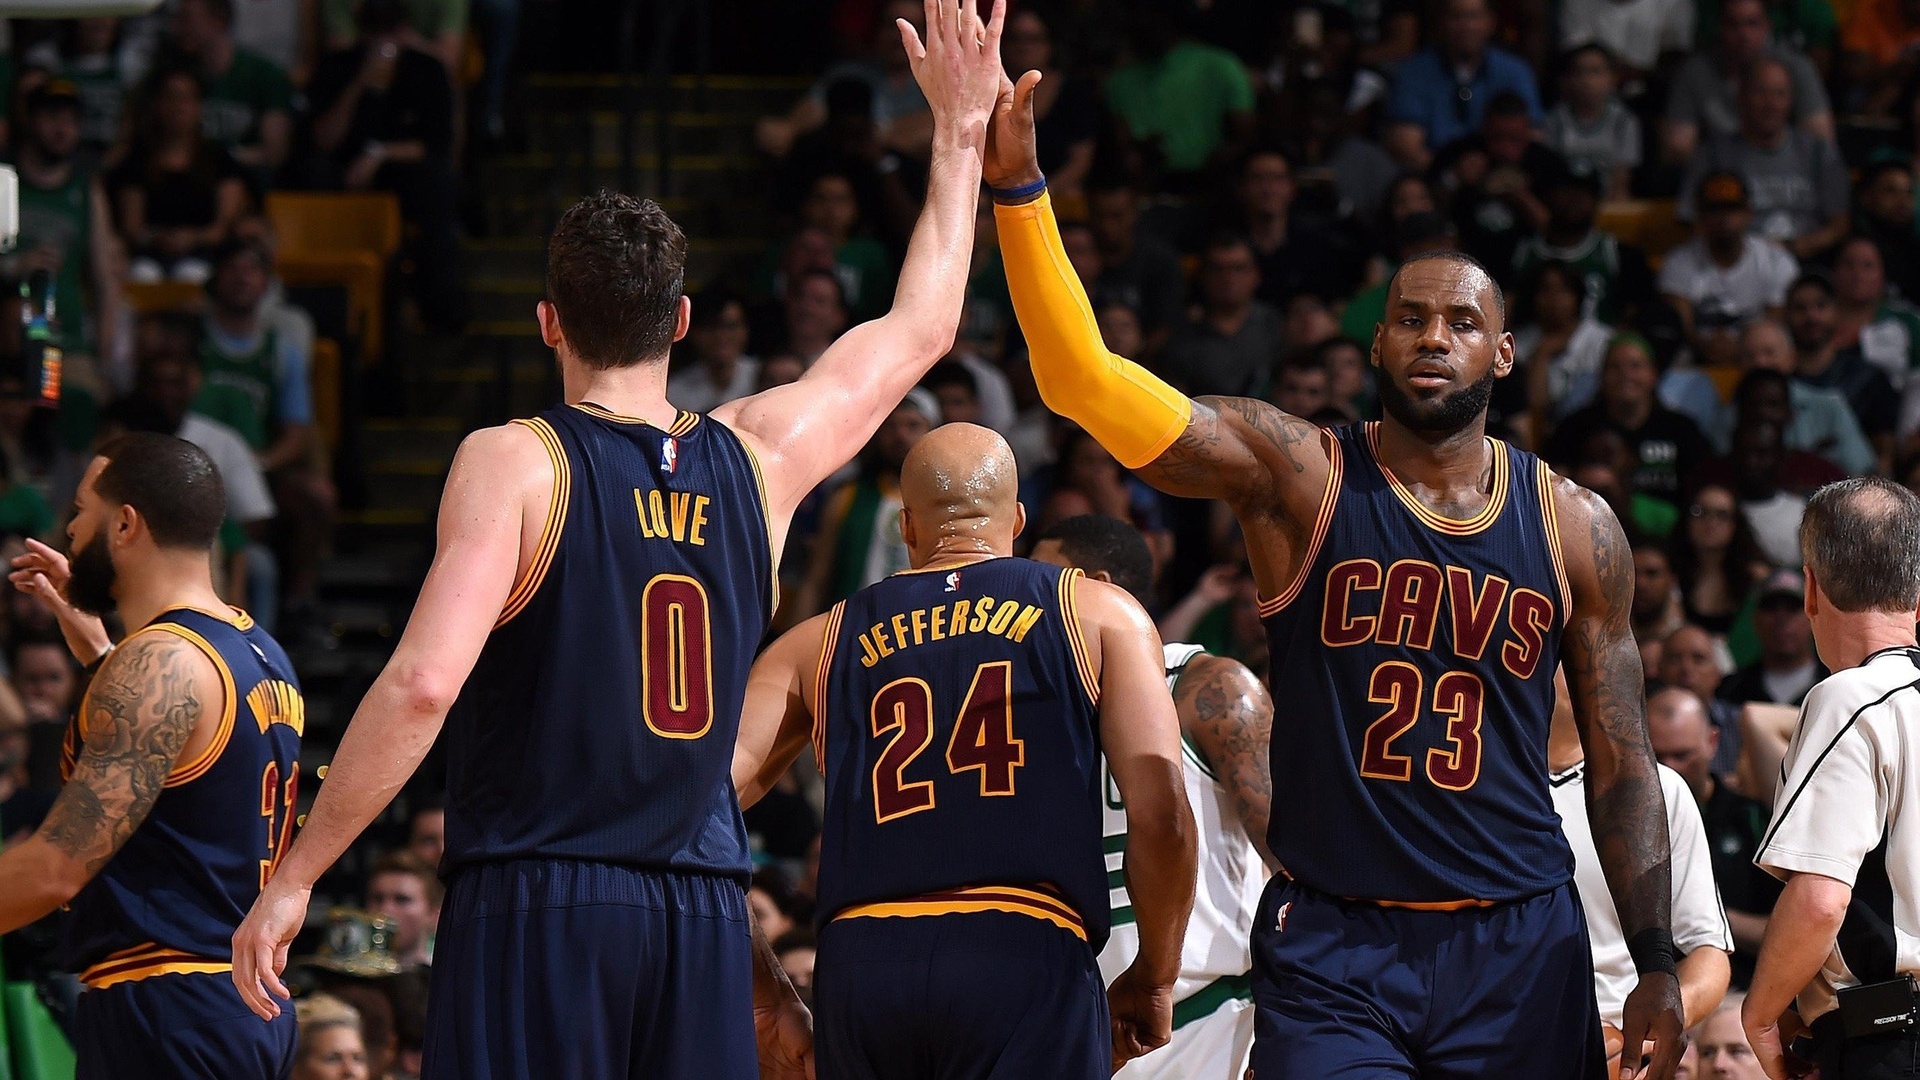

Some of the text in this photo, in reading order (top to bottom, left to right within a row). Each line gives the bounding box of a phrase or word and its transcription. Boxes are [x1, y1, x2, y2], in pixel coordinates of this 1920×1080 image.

[633, 488, 710, 546] LOVE
[641, 573, 714, 740] 0
[858, 596, 1044, 668] JEFFERSON
[1320, 558, 1554, 679] CAVS
[870, 660, 1025, 825] 24
[1360, 660, 1484, 791] 23
